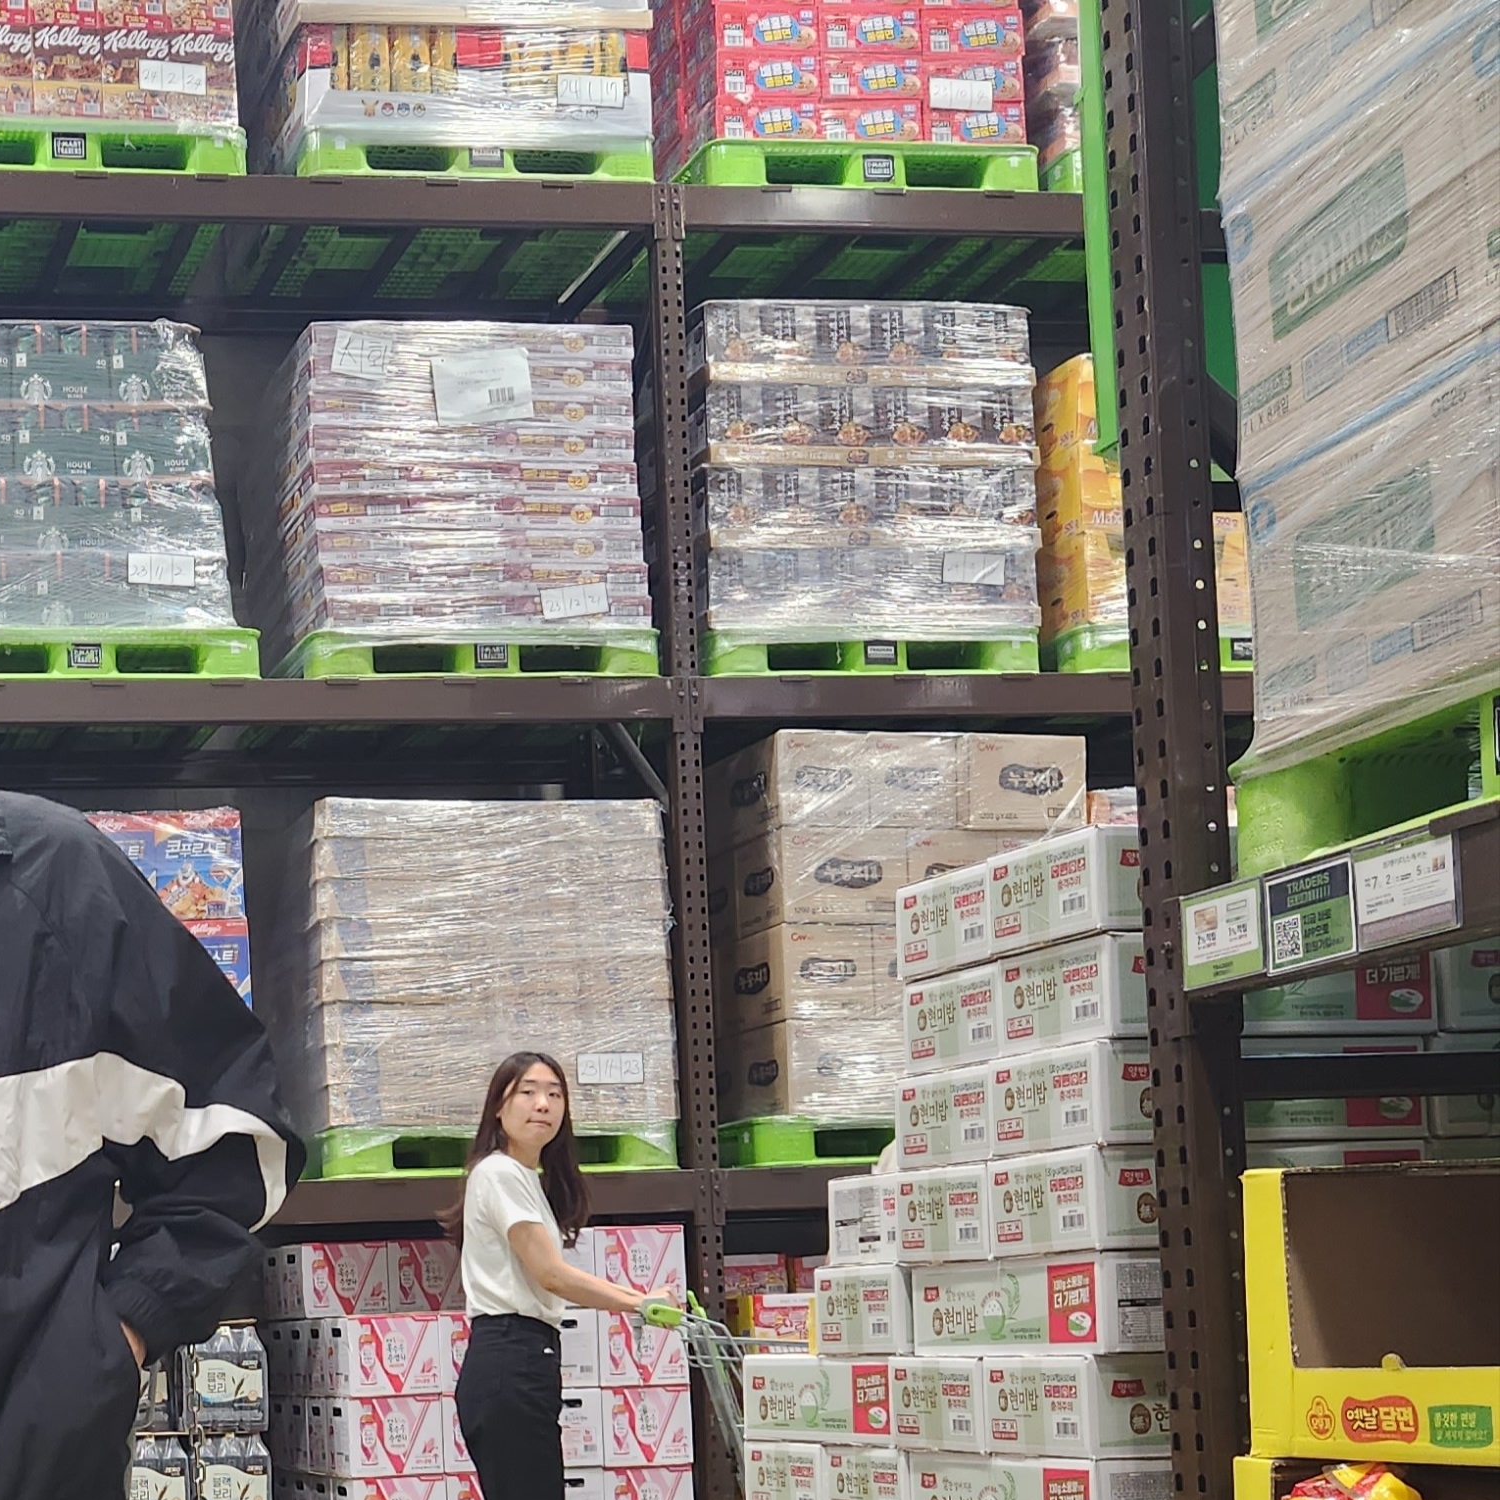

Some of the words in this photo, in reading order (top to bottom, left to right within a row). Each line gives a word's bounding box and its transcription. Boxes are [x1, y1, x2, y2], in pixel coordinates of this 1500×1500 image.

[63, 386, 88, 395] HOUSE
[66, 461, 92, 470] HOUSE
[164, 459, 189, 468] HOUSE
[1012, 872, 1045, 903] 현미밥
[1287, 872, 1330, 894] TRADERS
[921, 903, 948, 931] 현미밥
[1024, 979, 1058, 1012] 현미밥
[1014, 1081, 1048, 1113] 현미밥
[1013, 1187, 1044, 1213] 현미밥
[943, 1305, 979, 1336] 현미밥
[1346, 1408, 1379, 1431] 옛날
